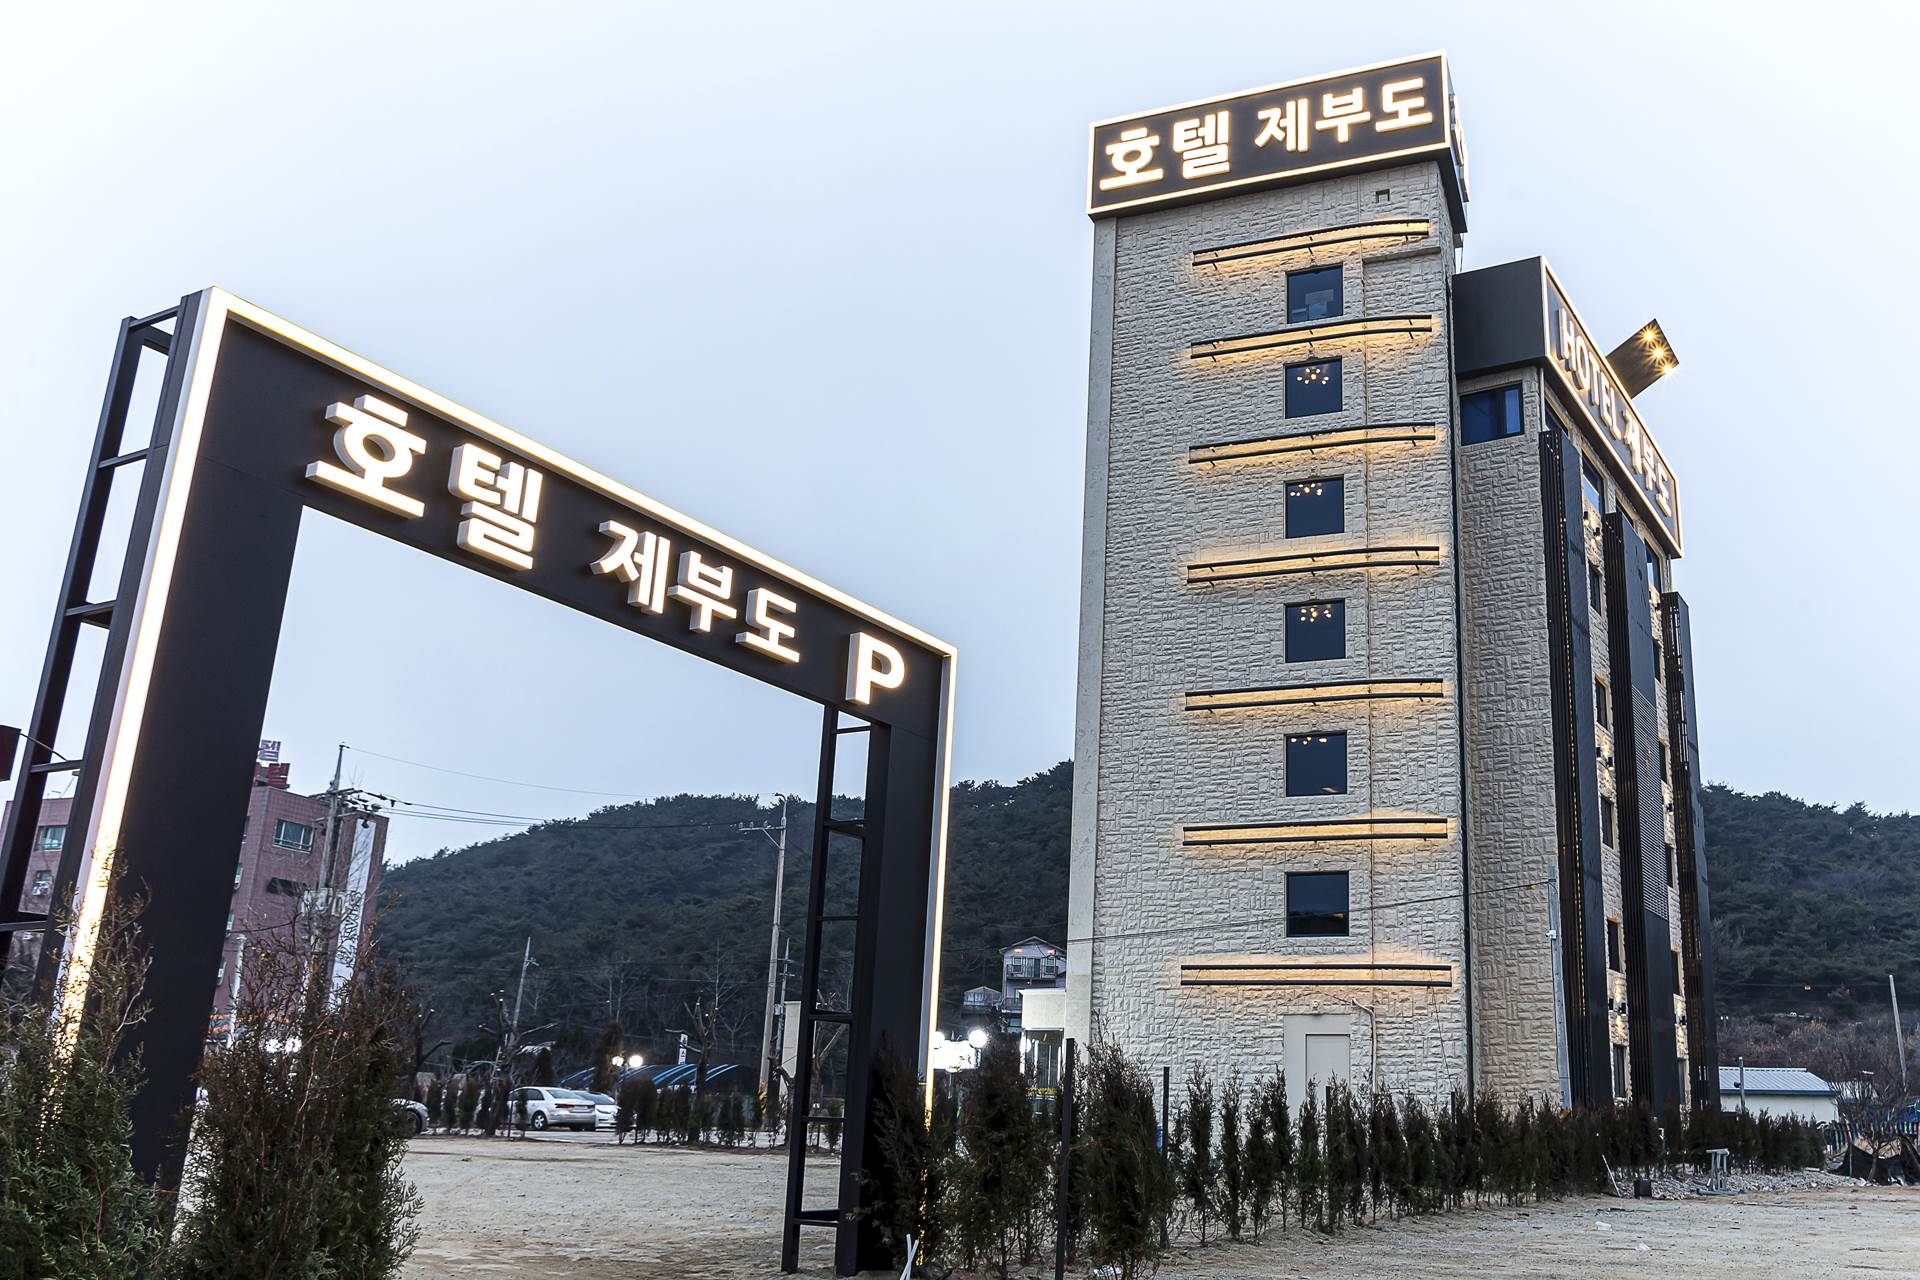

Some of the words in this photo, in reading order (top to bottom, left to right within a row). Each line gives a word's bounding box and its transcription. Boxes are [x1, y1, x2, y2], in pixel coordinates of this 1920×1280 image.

[1098, 109, 1232, 192] 호텔
[1253, 76, 1434, 154] 제부도
[1557, 306, 1622, 441] HOTEL
[1622, 408, 1672, 518] 제부도
[304, 394, 544, 571] 호텔
[589, 518, 801, 664] 제부도
[844, 631, 906, 706] P
